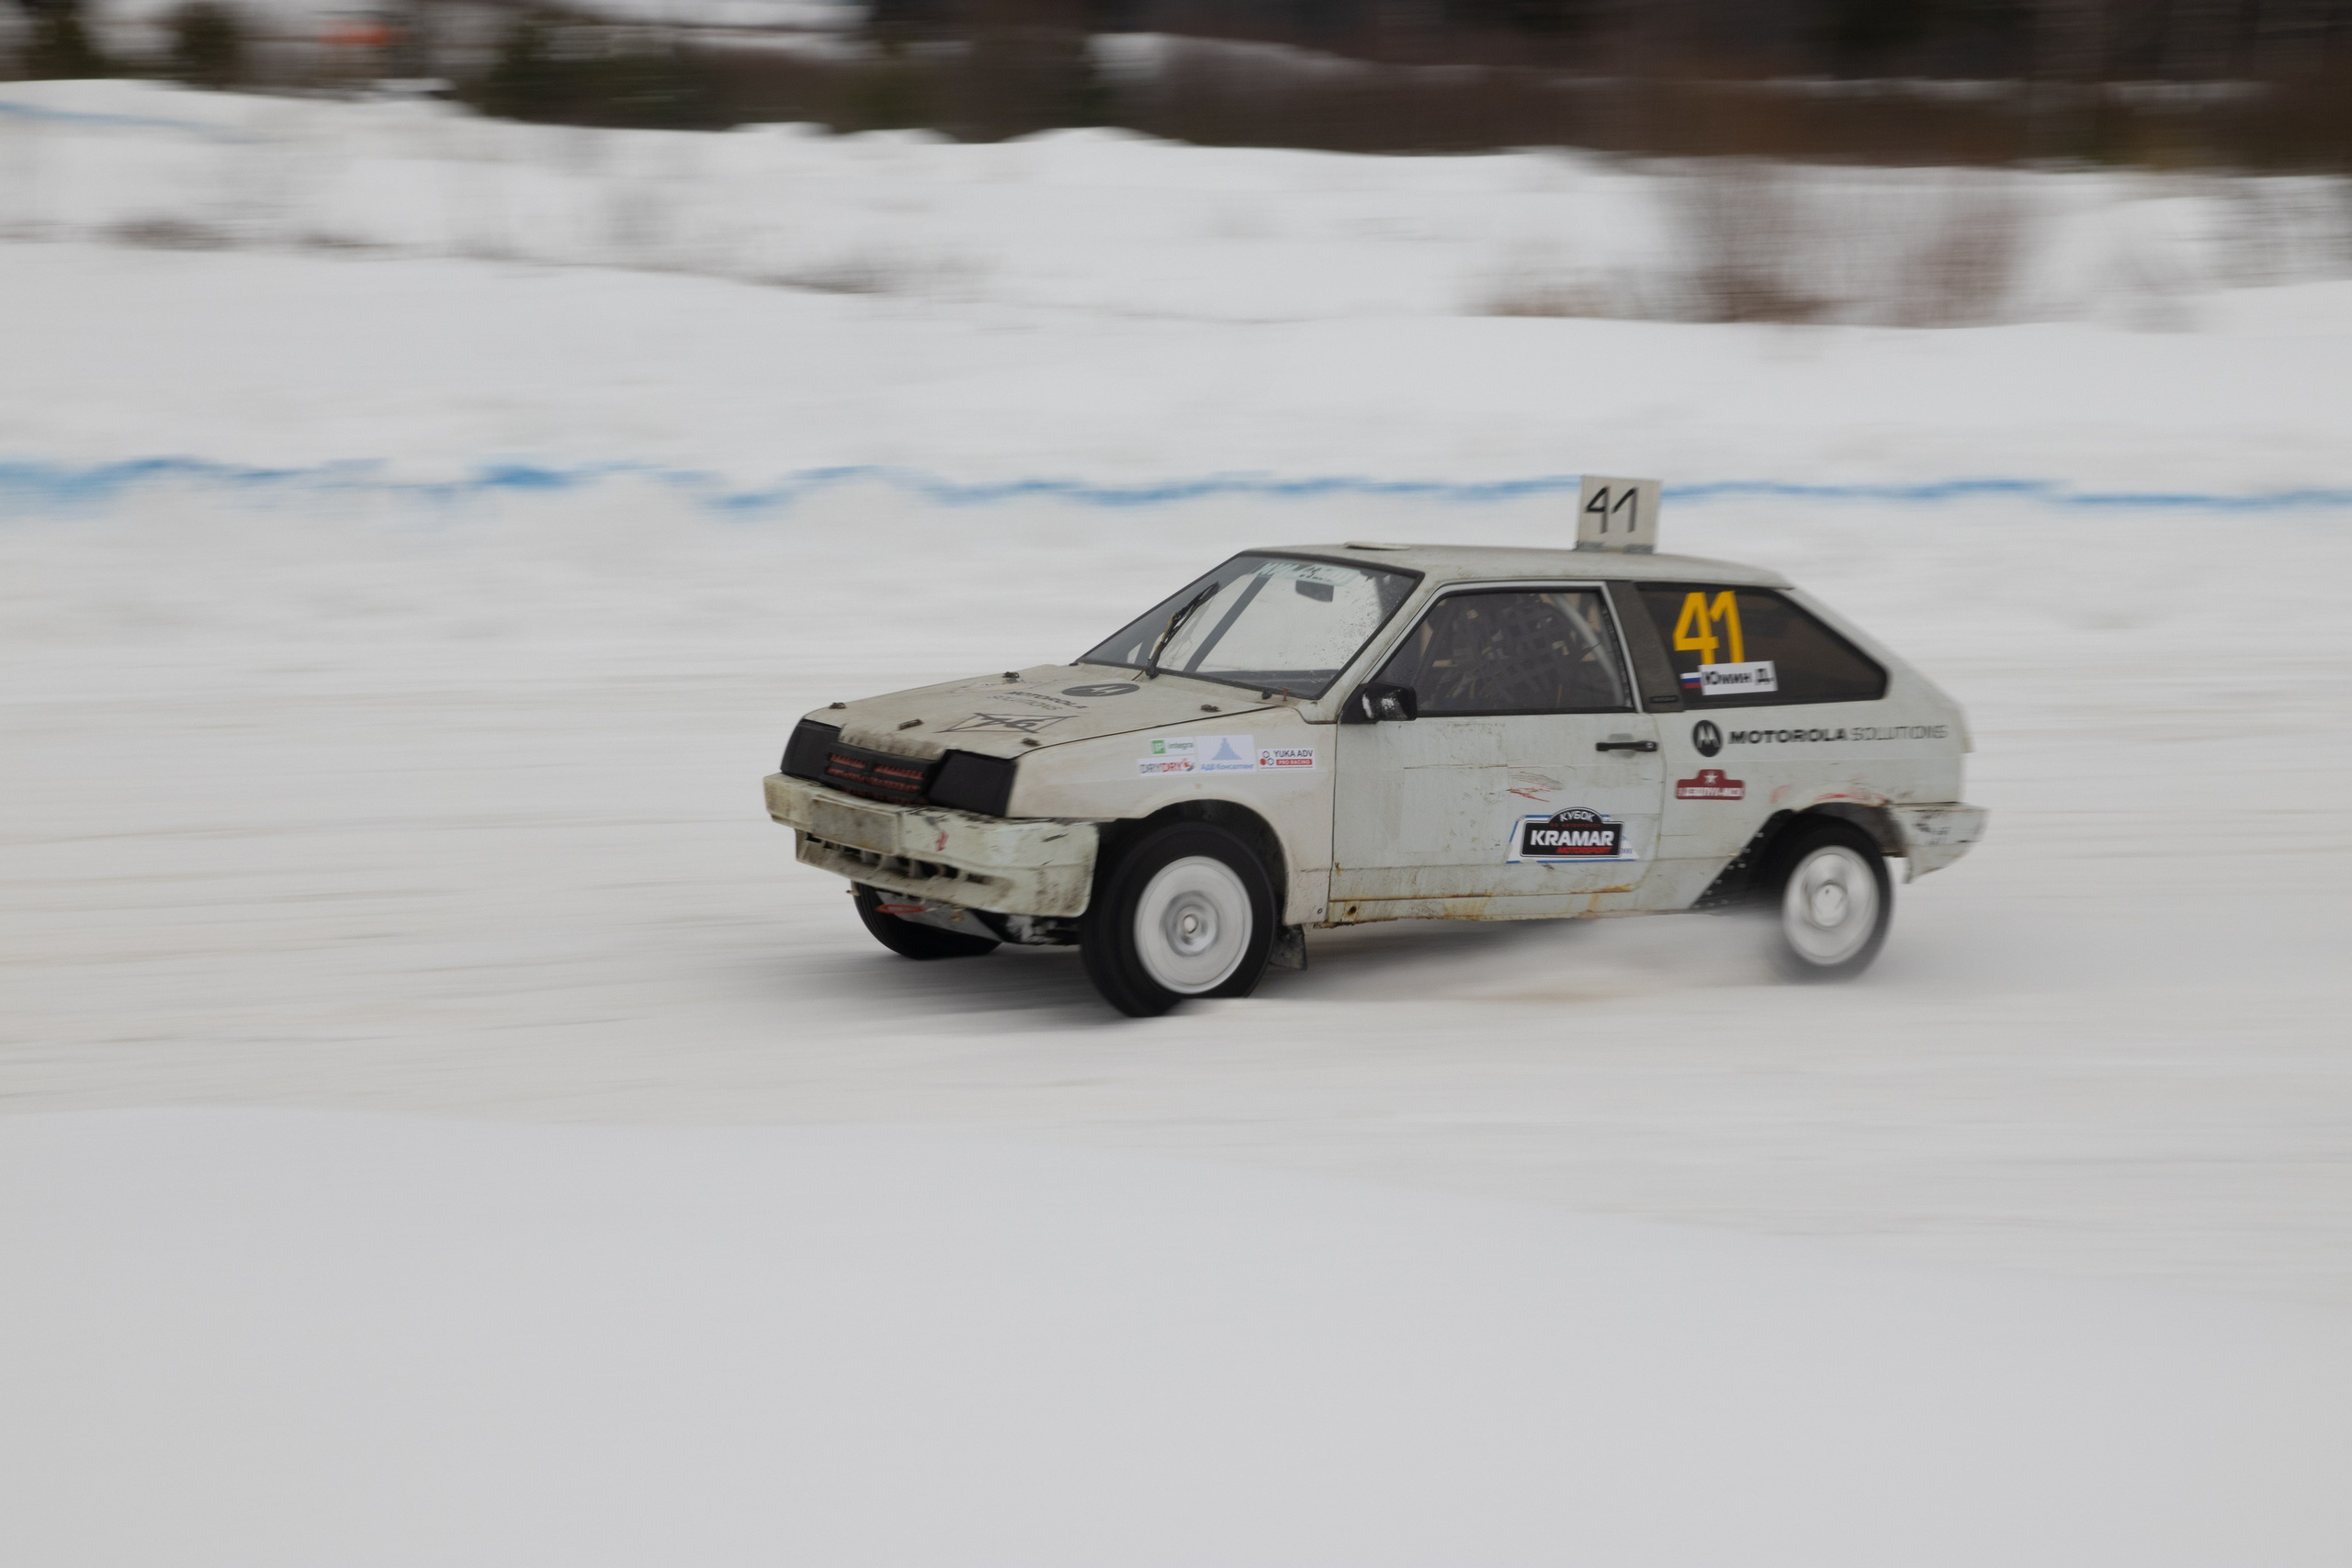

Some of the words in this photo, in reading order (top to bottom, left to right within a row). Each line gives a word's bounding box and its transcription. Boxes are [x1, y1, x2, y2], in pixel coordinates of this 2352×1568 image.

[1584, 485, 1639, 534] 41
[1673, 591, 1745, 665] 41
[1727, 727, 1849, 745] MOTOROLA
[1849, 725, 1949, 741] SOLUTIONS
[1273, 750, 1296, 758] YUKA
[1297, 750, 1314, 758] ADV
[1559, 810, 1596, 823] КУБОК
[1530, 829, 1615, 847] KRAMAR
